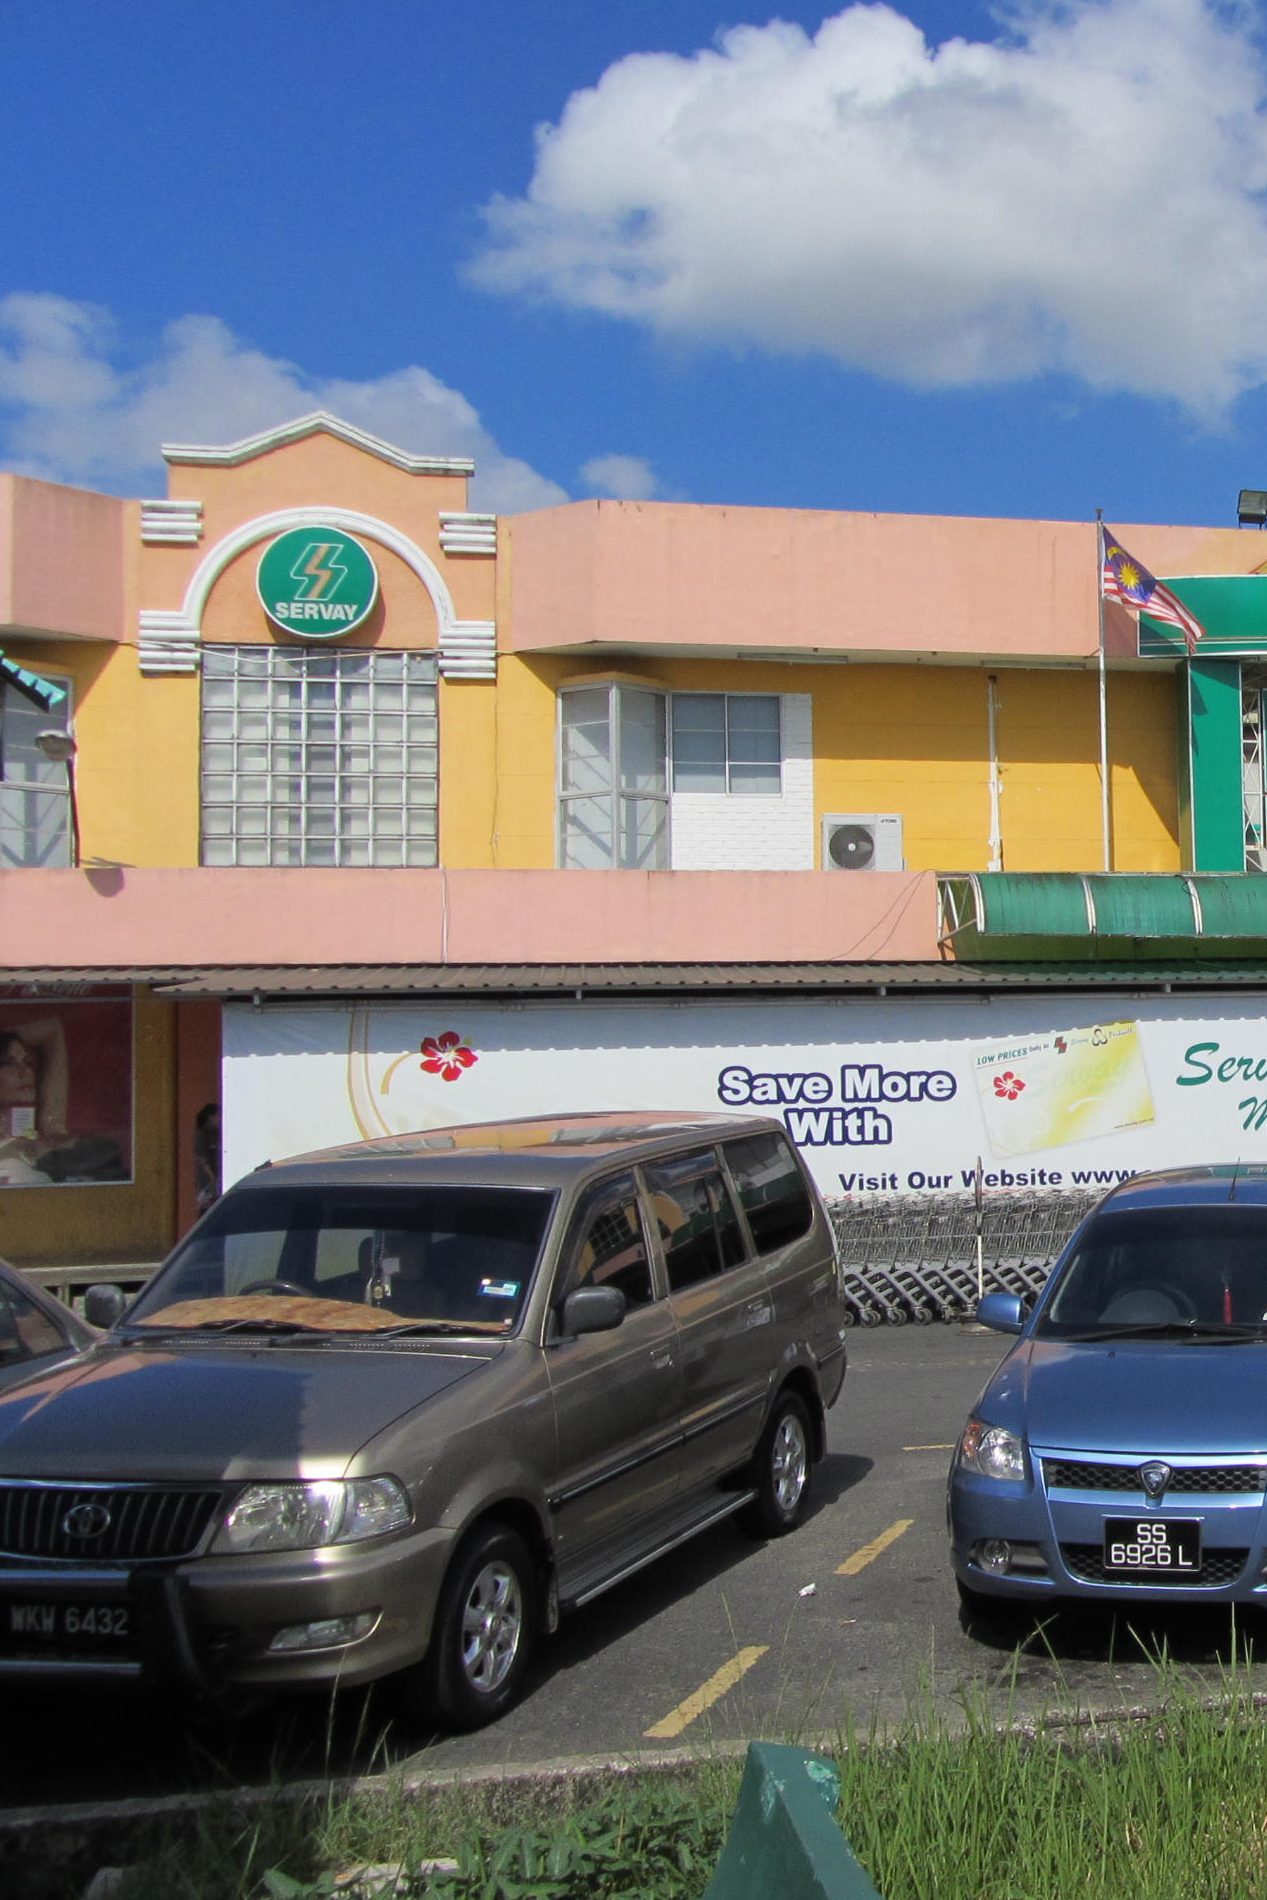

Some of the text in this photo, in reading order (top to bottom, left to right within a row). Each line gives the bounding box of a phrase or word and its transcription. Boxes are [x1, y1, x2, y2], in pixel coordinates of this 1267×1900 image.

[275, 602, 358, 621] SERVAY
[976, 1055, 995, 1066] LOW
[997, 1048, 1028, 1062] PRICES
[718, 1064, 957, 1105] Save More
[784, 1107, 893, 1146] With
[838, 1172, 898, 1191] Visit
[907, 1171, 953, 1189] Our
[961, 1168, 1063, 1188] Website
[1136, 1523, 1167, 1544] SS
[1111, 1543, 1193, 1566] 6926 L
[11, 1604, 129, 1635] WKW 6432
